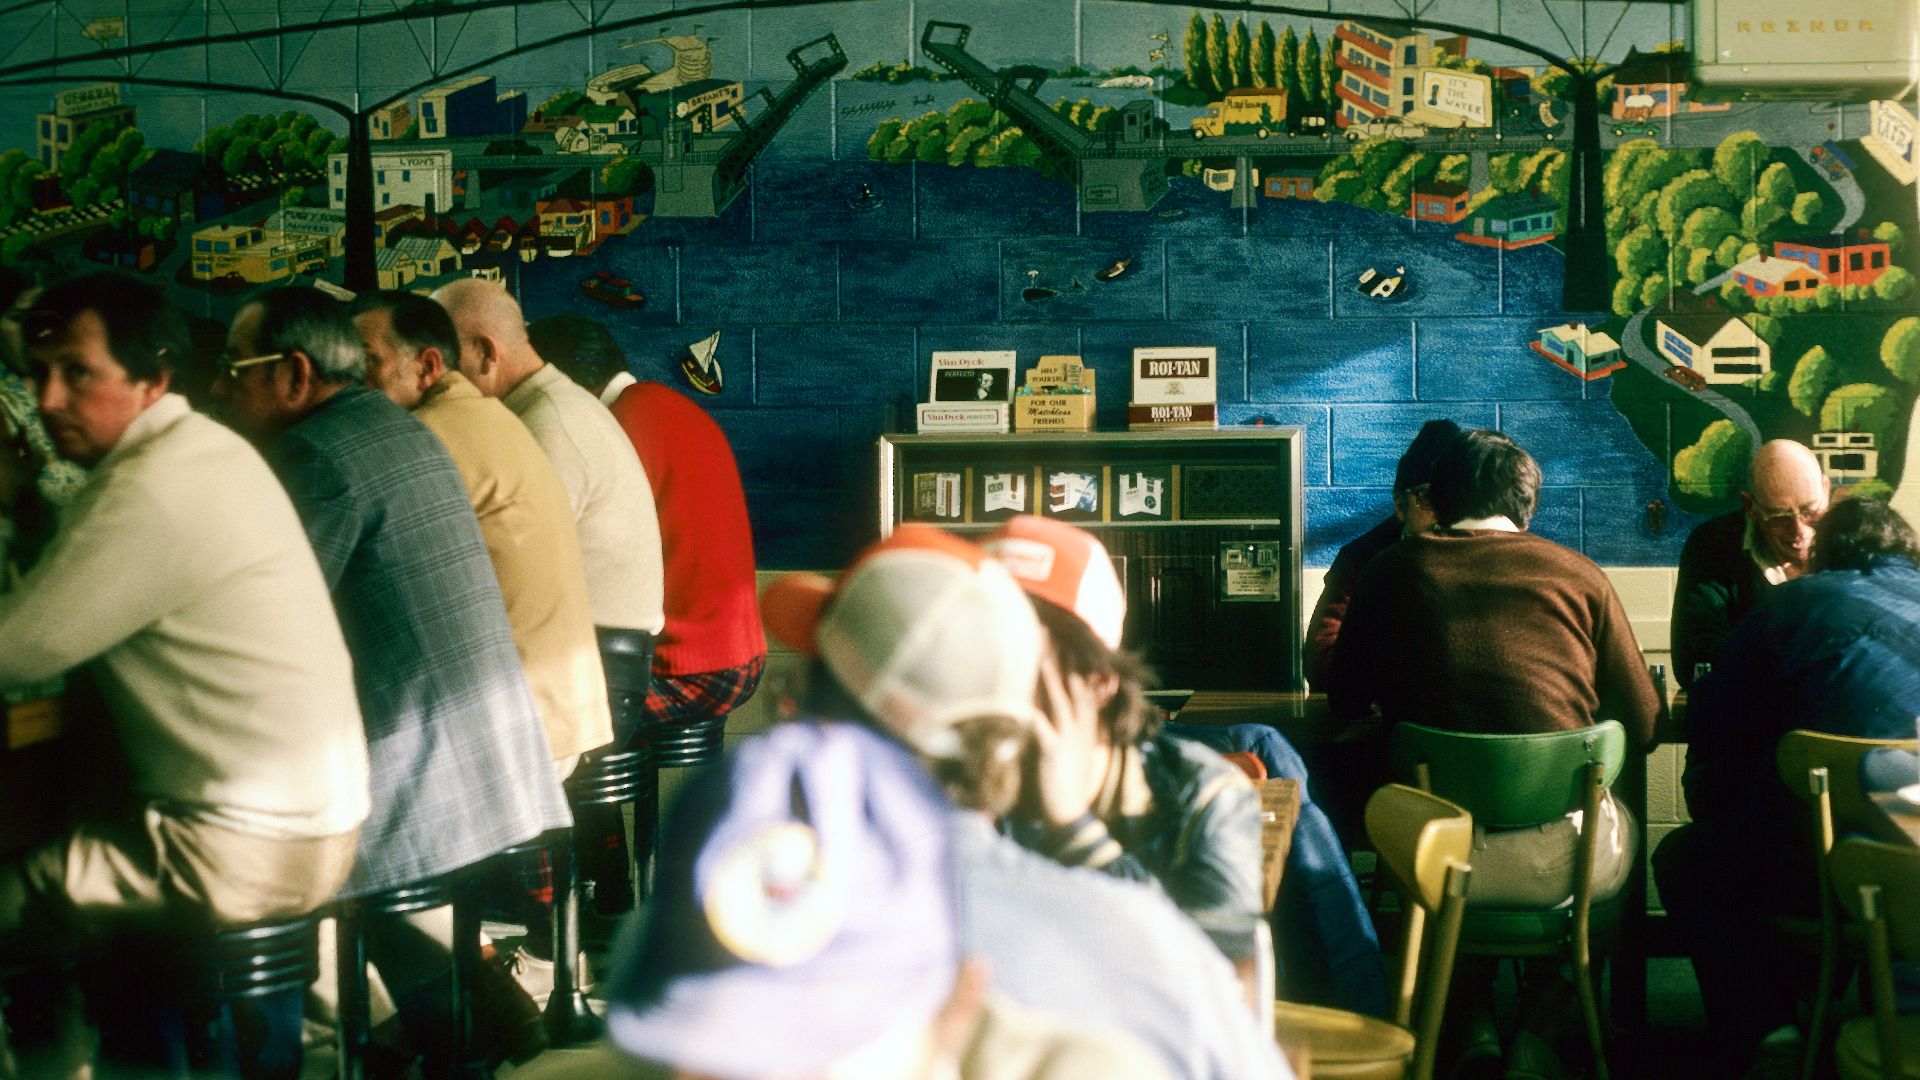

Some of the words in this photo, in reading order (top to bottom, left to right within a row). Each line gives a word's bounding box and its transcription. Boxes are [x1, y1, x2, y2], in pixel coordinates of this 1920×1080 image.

[1737, 19, 1875, 33] REZNOR
[1444, 97, 1482, 115] WATER
[1148, 360, 1200, 376] ROI-TAN
[1028, 408, 1071, 416] Matchless
[1151, 406, 1192, 418] ROI-TAN
[1033, 417, 1066, 425] FRIENDS
